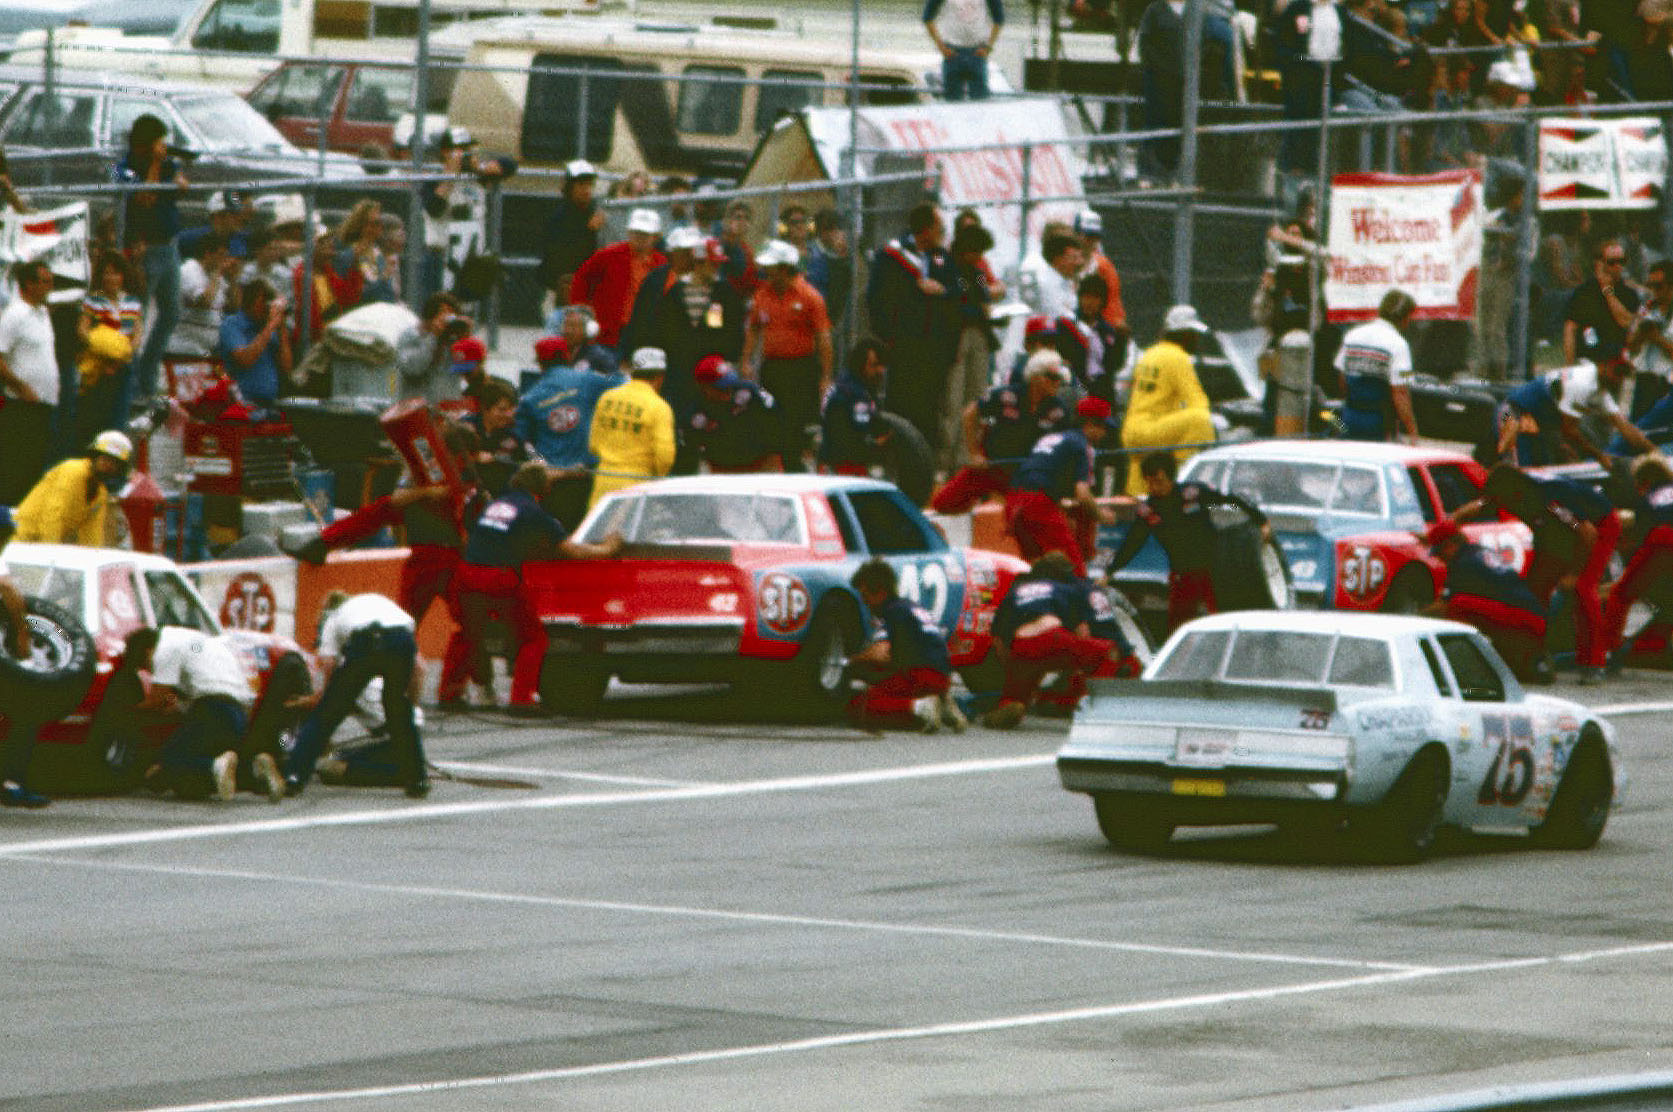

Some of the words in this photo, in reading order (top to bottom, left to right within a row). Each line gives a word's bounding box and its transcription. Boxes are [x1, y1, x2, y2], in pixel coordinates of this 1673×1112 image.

[1350, 207, 1441, 244] Welcome
[1344, 547, 1385, 596] STP
[229, 581, 272, 630] STP
[760, 574, 808, 622] STP
